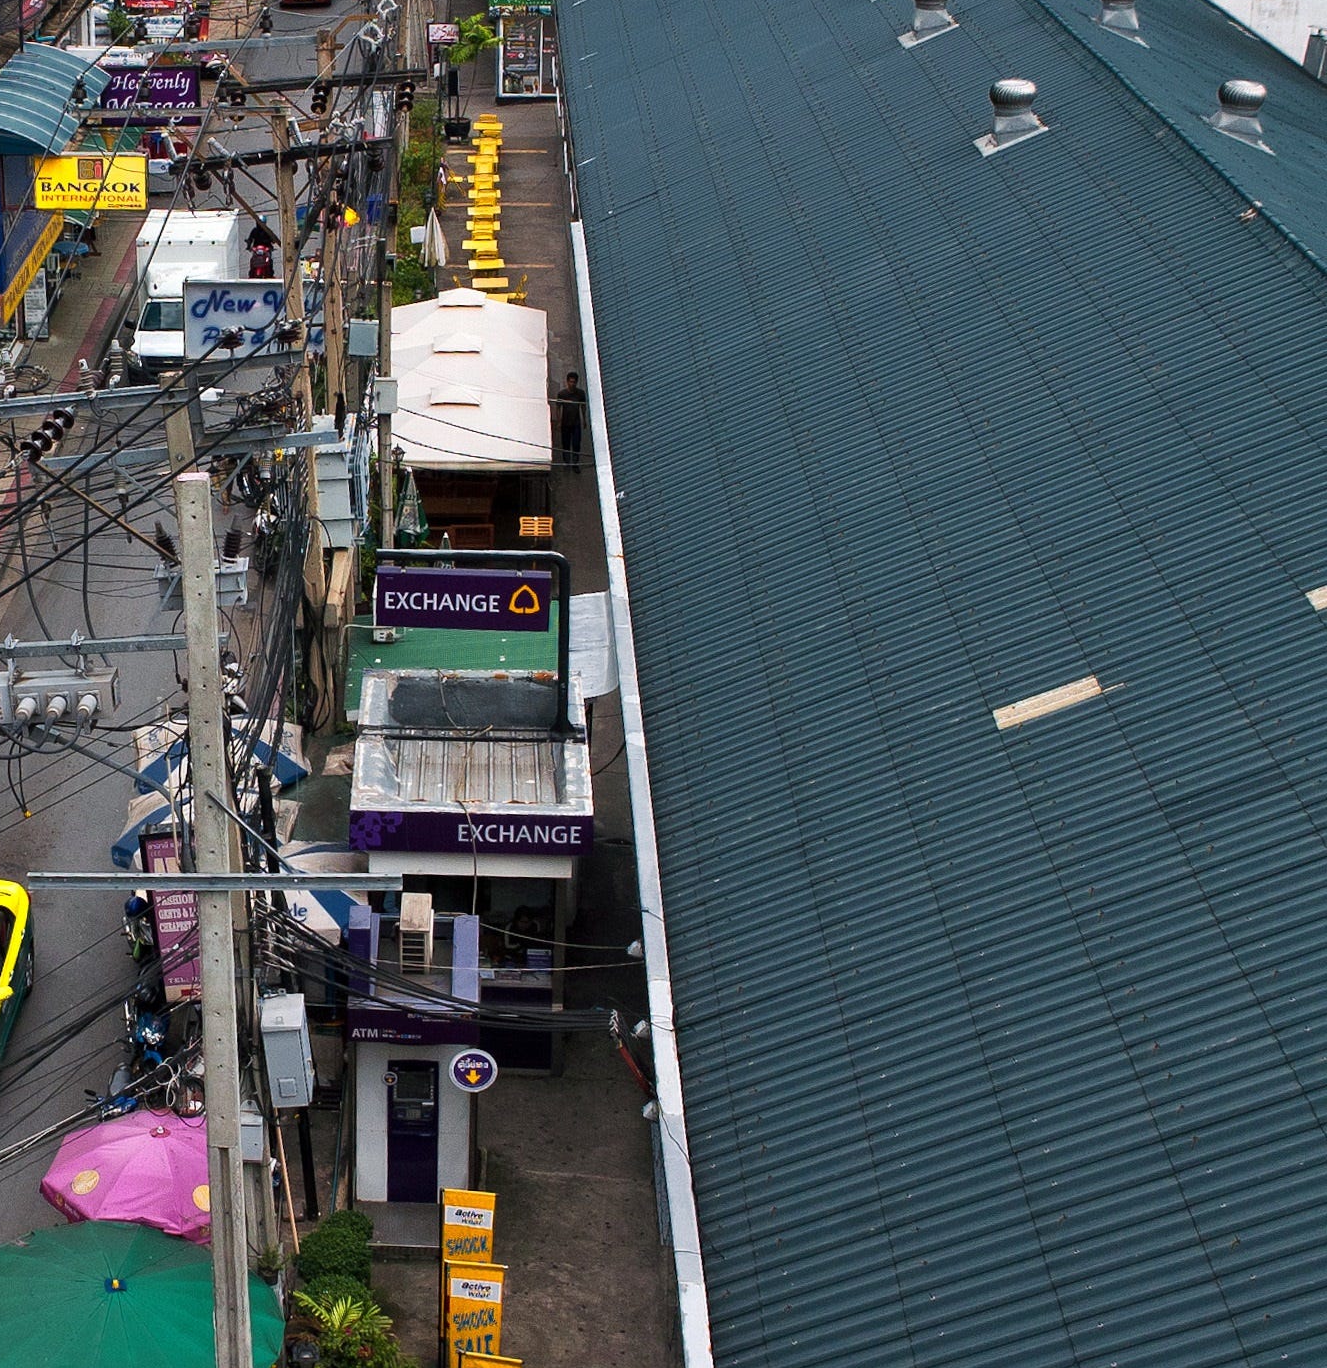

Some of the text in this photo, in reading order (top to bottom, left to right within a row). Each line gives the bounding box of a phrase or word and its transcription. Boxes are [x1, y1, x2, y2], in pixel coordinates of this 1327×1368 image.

[41, 182, 141, 193] BANGKOK
[41, 194, 142, 203] INTERNATIONAL
[191, 289, 256, 318] New
[384, 591, 501, 614] EXCHANGE
[457, 823, 583, 845] EXCHANGE
[352, 1028, 378, 1039] ATM
[461, 1281, 491, 1292] active
